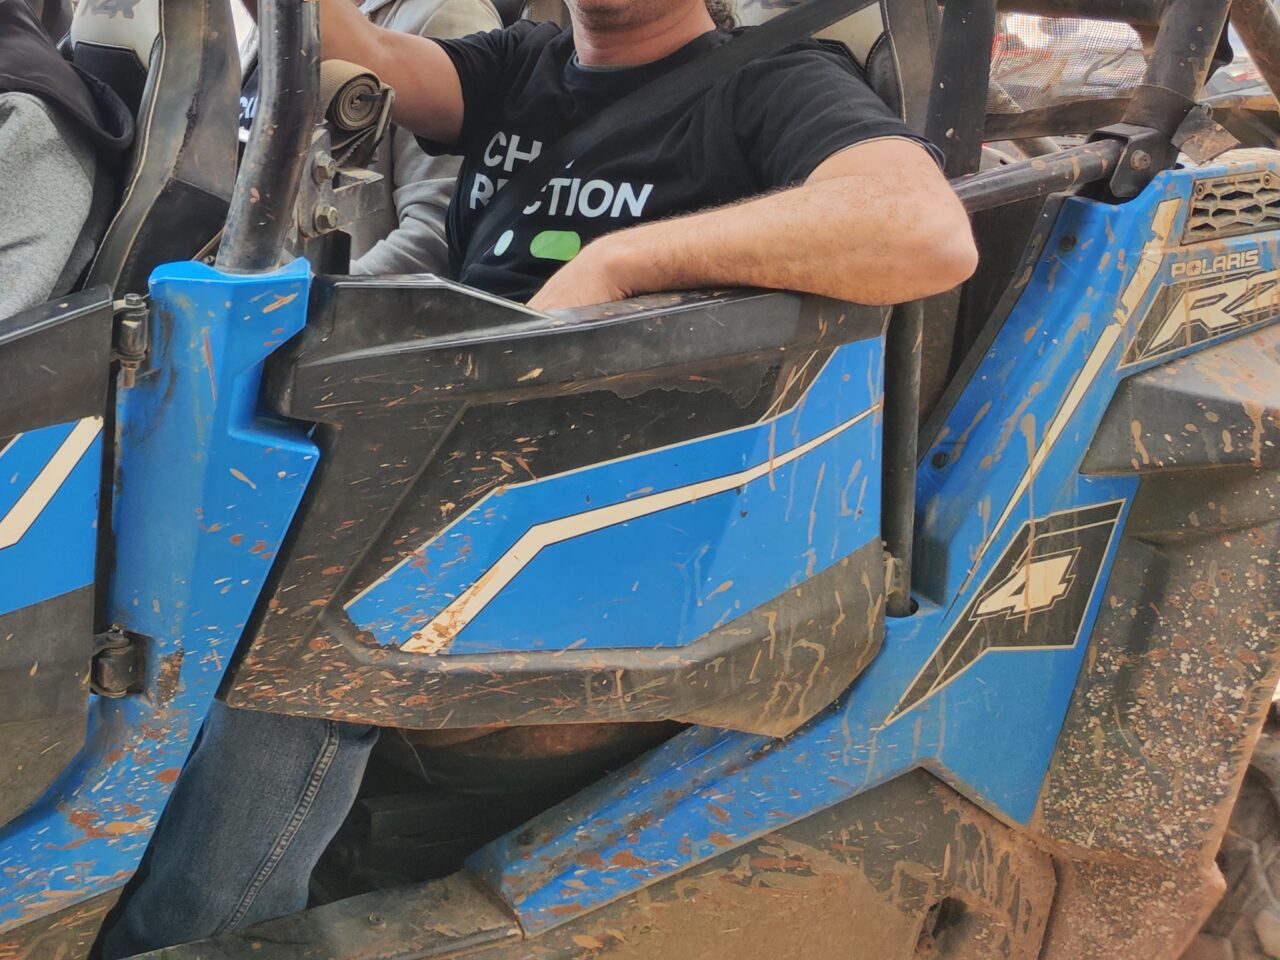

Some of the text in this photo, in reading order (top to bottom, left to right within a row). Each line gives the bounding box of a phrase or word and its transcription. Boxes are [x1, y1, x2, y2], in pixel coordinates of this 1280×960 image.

[470, 173, 654, 218] RTION
[1171, 249, 1259, 278] POLARIS
[976, 555, 1074, 615] 4
